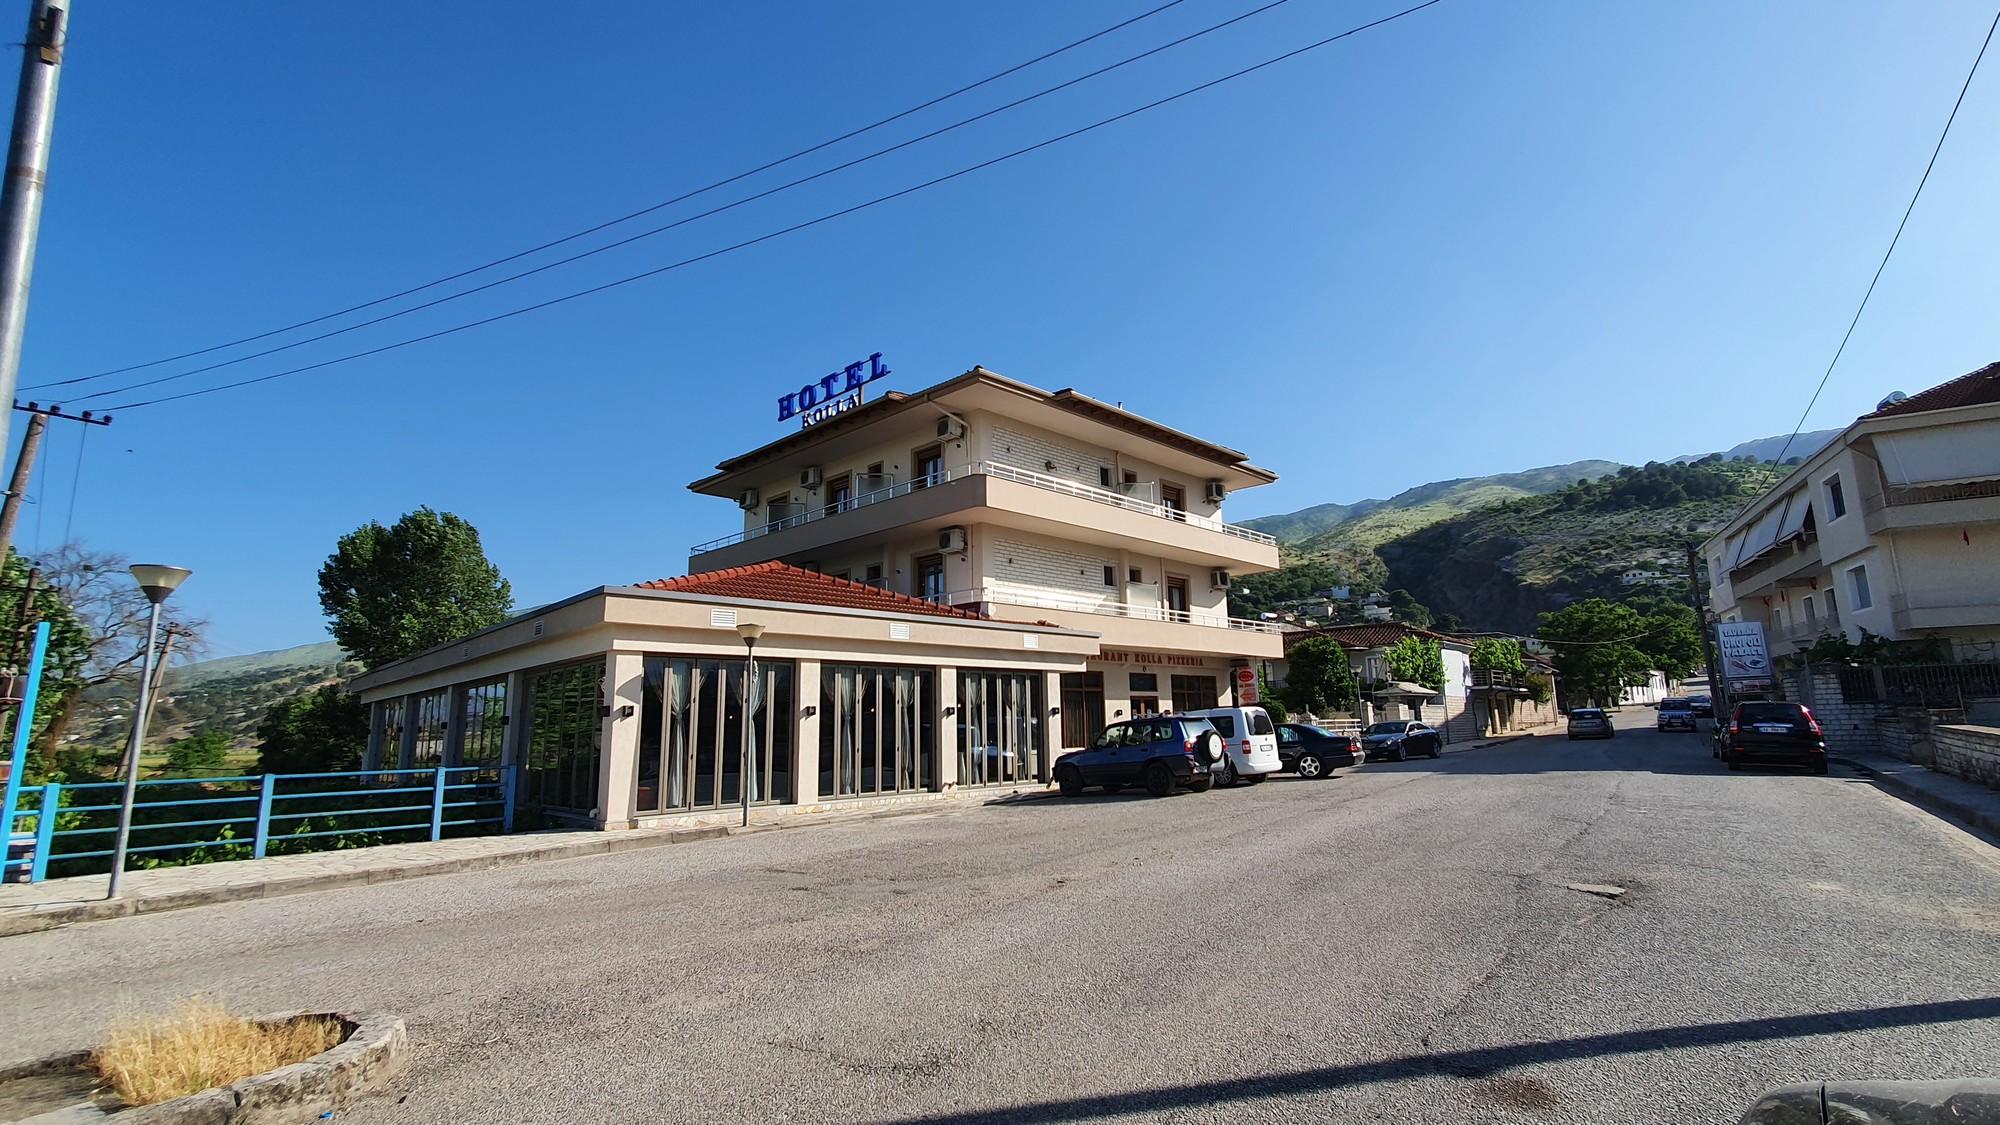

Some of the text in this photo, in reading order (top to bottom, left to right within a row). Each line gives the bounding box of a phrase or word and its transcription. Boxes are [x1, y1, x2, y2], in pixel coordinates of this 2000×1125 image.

[778, 352, 891, 421] HOTEL
[802, 394, 860, 429] KOLLA
[1134, 653, 1163, 665] KOLLA
[1167, 655, 1204, 667] PIZZERIA
